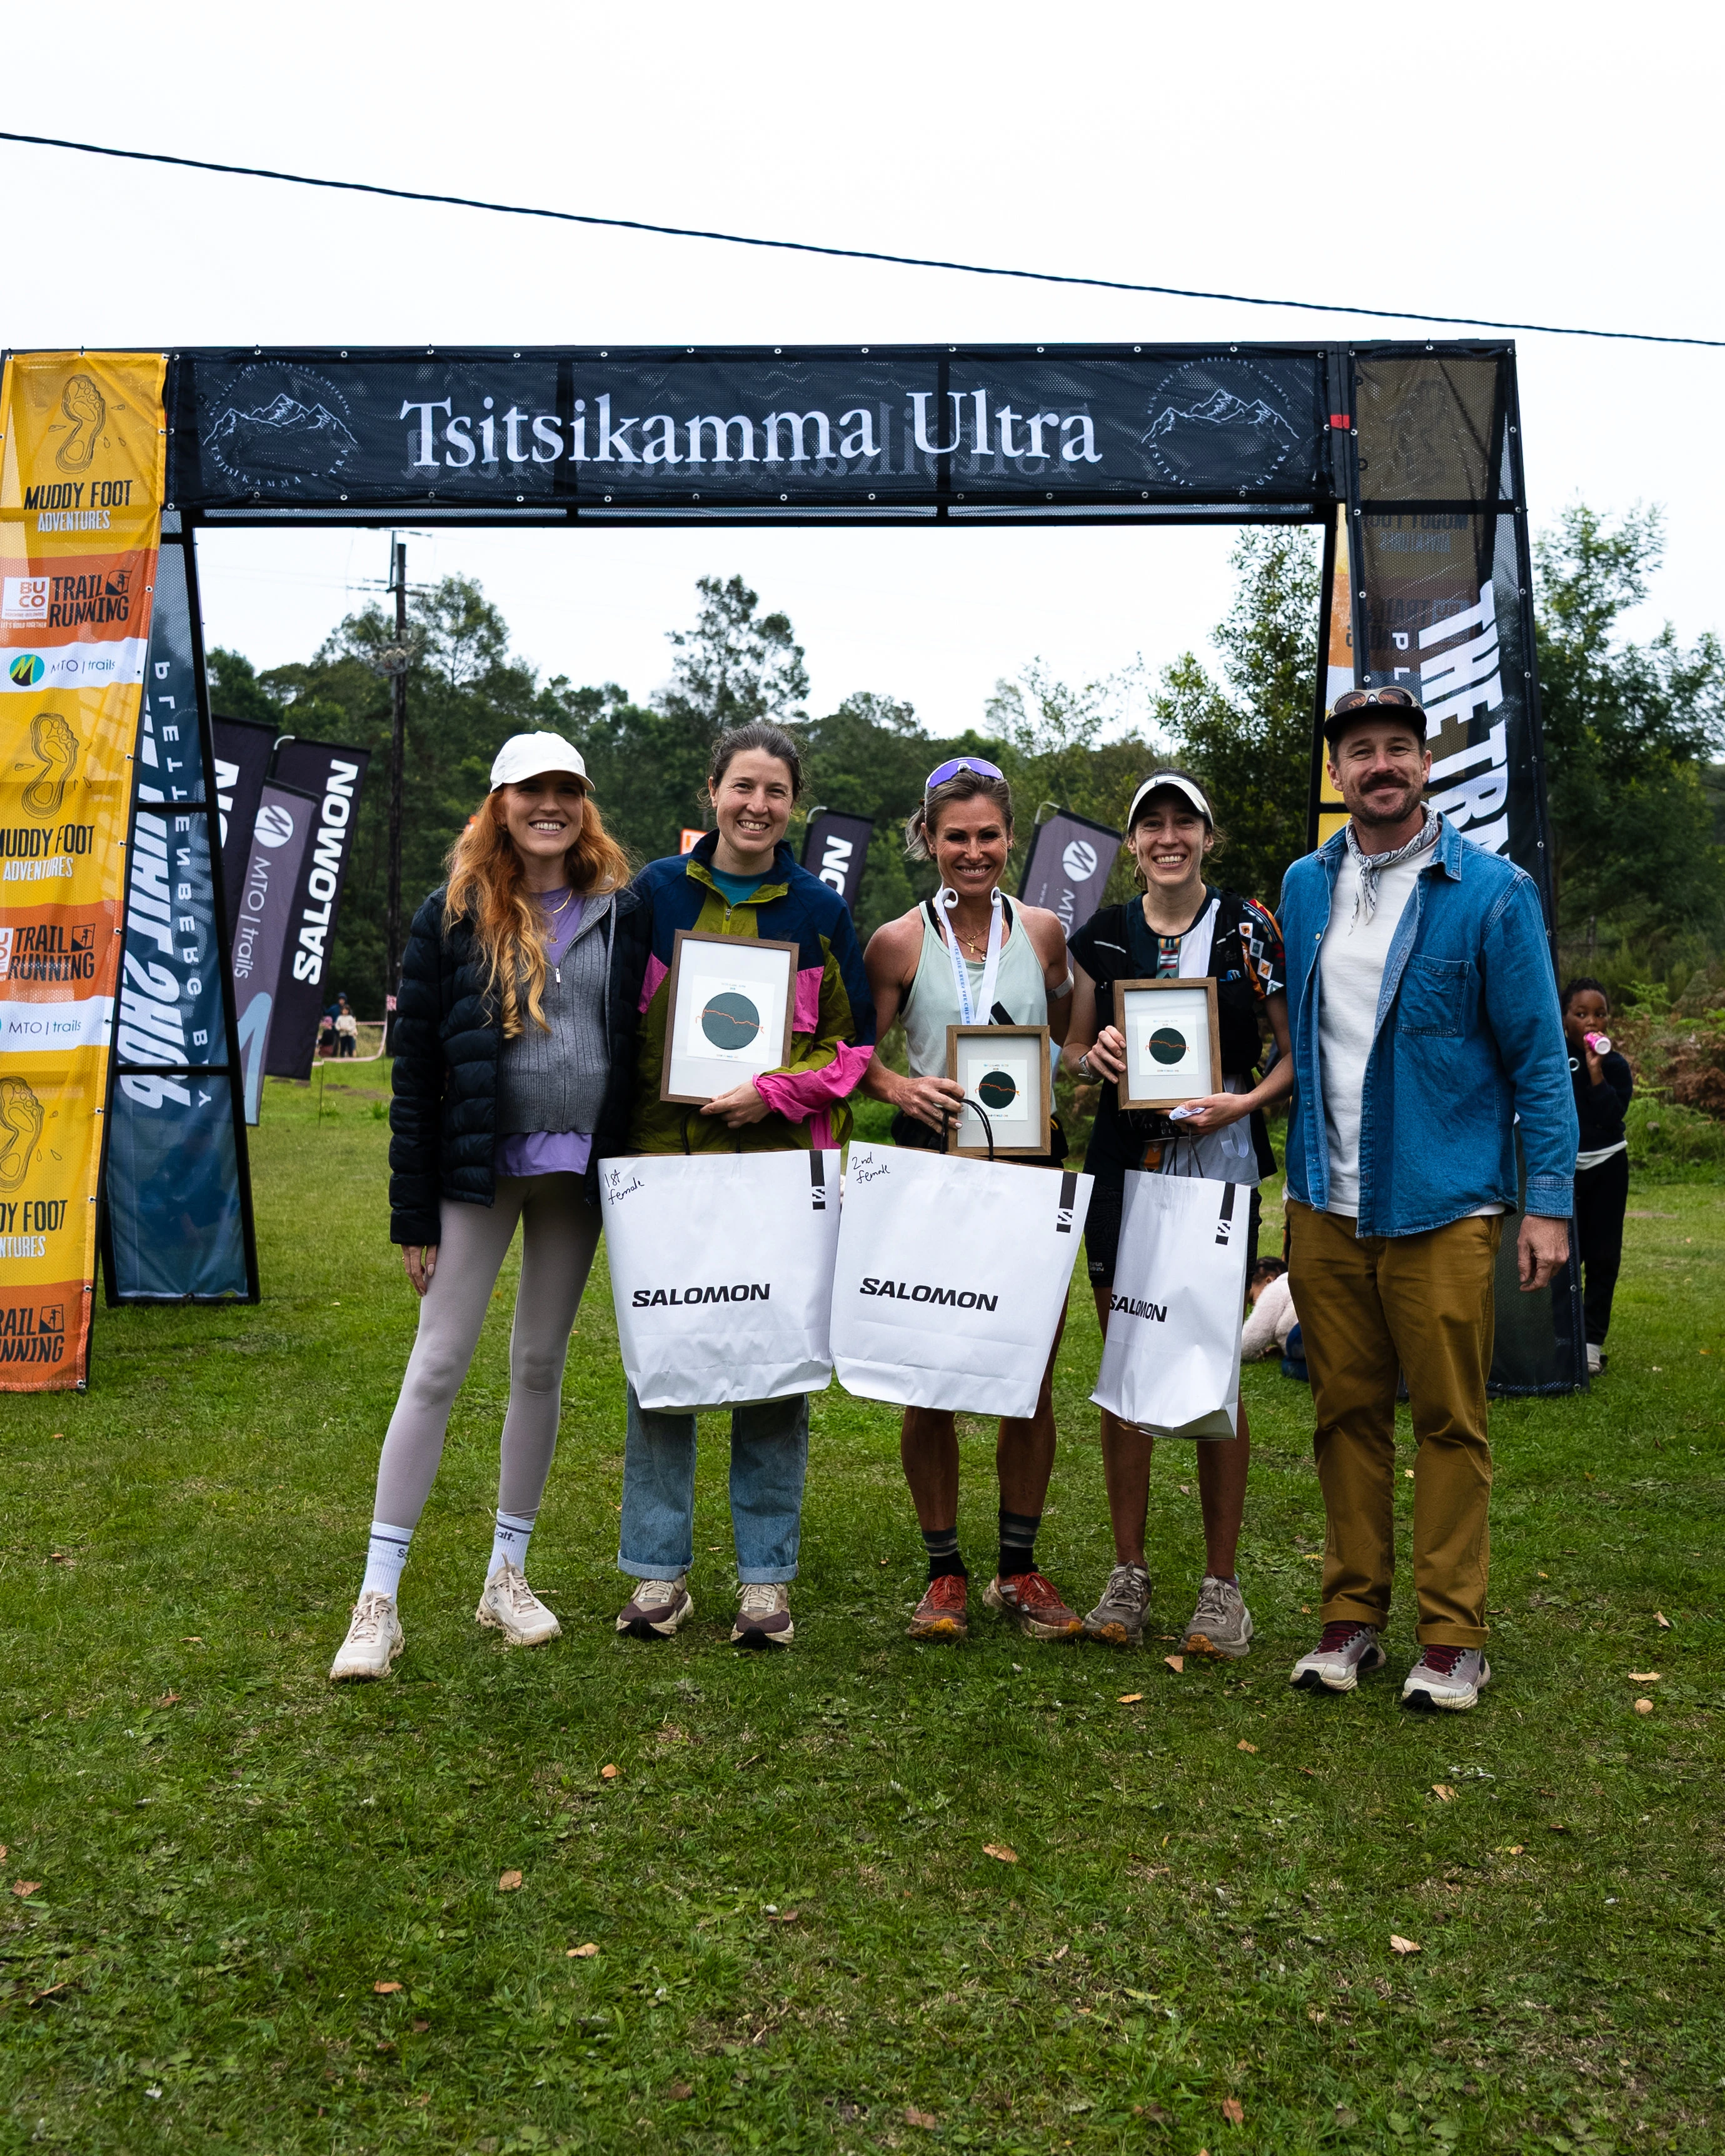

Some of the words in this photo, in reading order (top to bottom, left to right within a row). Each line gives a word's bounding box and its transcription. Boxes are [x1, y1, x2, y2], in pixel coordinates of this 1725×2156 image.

[400, 393, 882, 468] Tsitsikamma
[905, 389, 1103, 463] Ultra
[24, 482, 84, 510] MUDDY
[91, 479, 133, 508] FOOT
[38, 510, 111, 532] ADVENTURES
[53, 574, 102, 601] TRAIL
[49, 596, 129, 628] RUNNING
[88, 659, 115, 671] trails
[1418, 579, 1503, 740] THE
[55, 824, 95, 855] FOOT
[3, 856, 74, 881] ADVENTURES
[293, 759, 359, 985] SALOMON
[247, 856, 271, 911] MTO
[16, 925, 68, 953] TRAIL
[234, 926, 259, 979] trails
[8, 952, 94, 981] RUNNING
[9, 1021, 42, 1035] MTO
[53, 1020, 81, 1033] trails
[852, 1151, 873, 1170] 2nd
[604, 1168, 620, 1188] 1st
[23, 1200, 68, 1232] FOOT
[0, 1235, 46, 1258] NTURES
[631, 1283, 770, 1307] SALOMON
[859, 1277, 998, 1311] SALOMON
[1110, 1293, 1167, 1323] SALOMON
[0, 1308, 36, 1336] AIL
[0, 1335, 64, 1363] NNING
